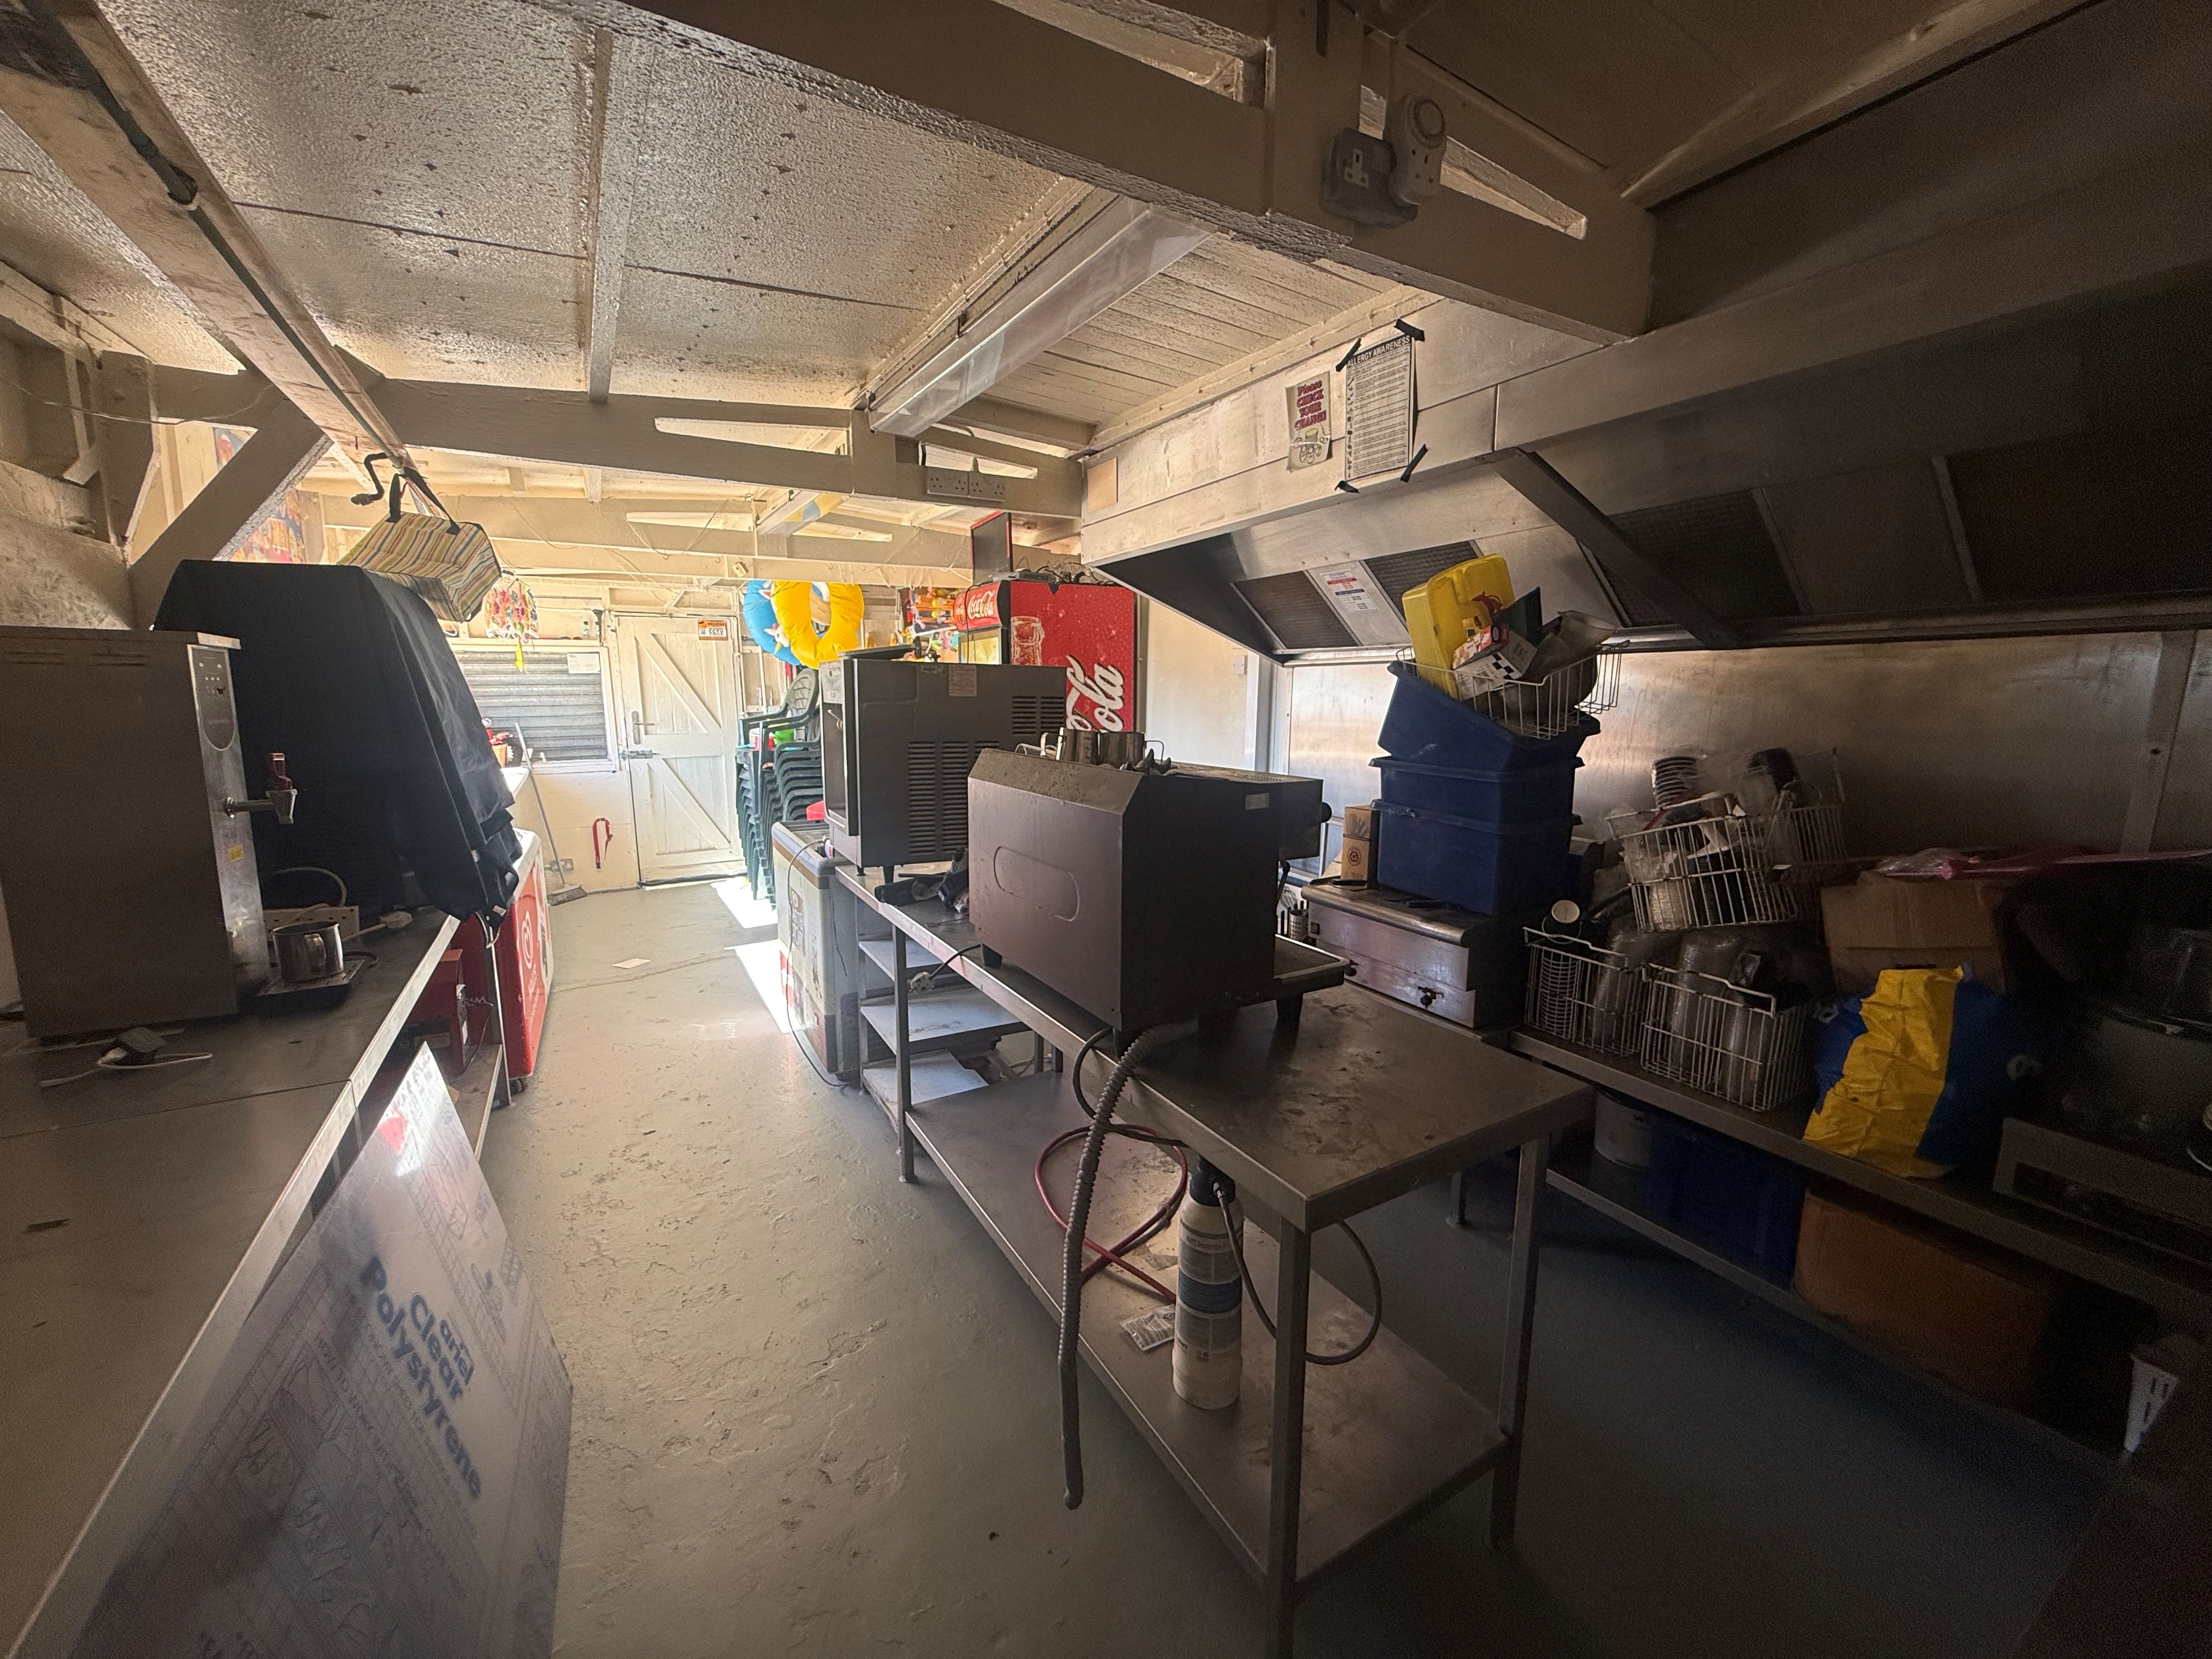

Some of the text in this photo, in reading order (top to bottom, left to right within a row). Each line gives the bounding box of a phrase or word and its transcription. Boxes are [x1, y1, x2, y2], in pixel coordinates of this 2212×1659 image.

[1347, 335, 1410, 368] ALLERGY AWARENESS
[1297, 380, 1322, 397] Please
[1297, 388, 1324, 408] CHECK
[1294, 410, 1327, 429] CHANGE
[411, 1294, 463, 1400] Clear
[440, 1319, 475, 1385] ariel
[359, 1255, 481, 1499] Polystyrene
